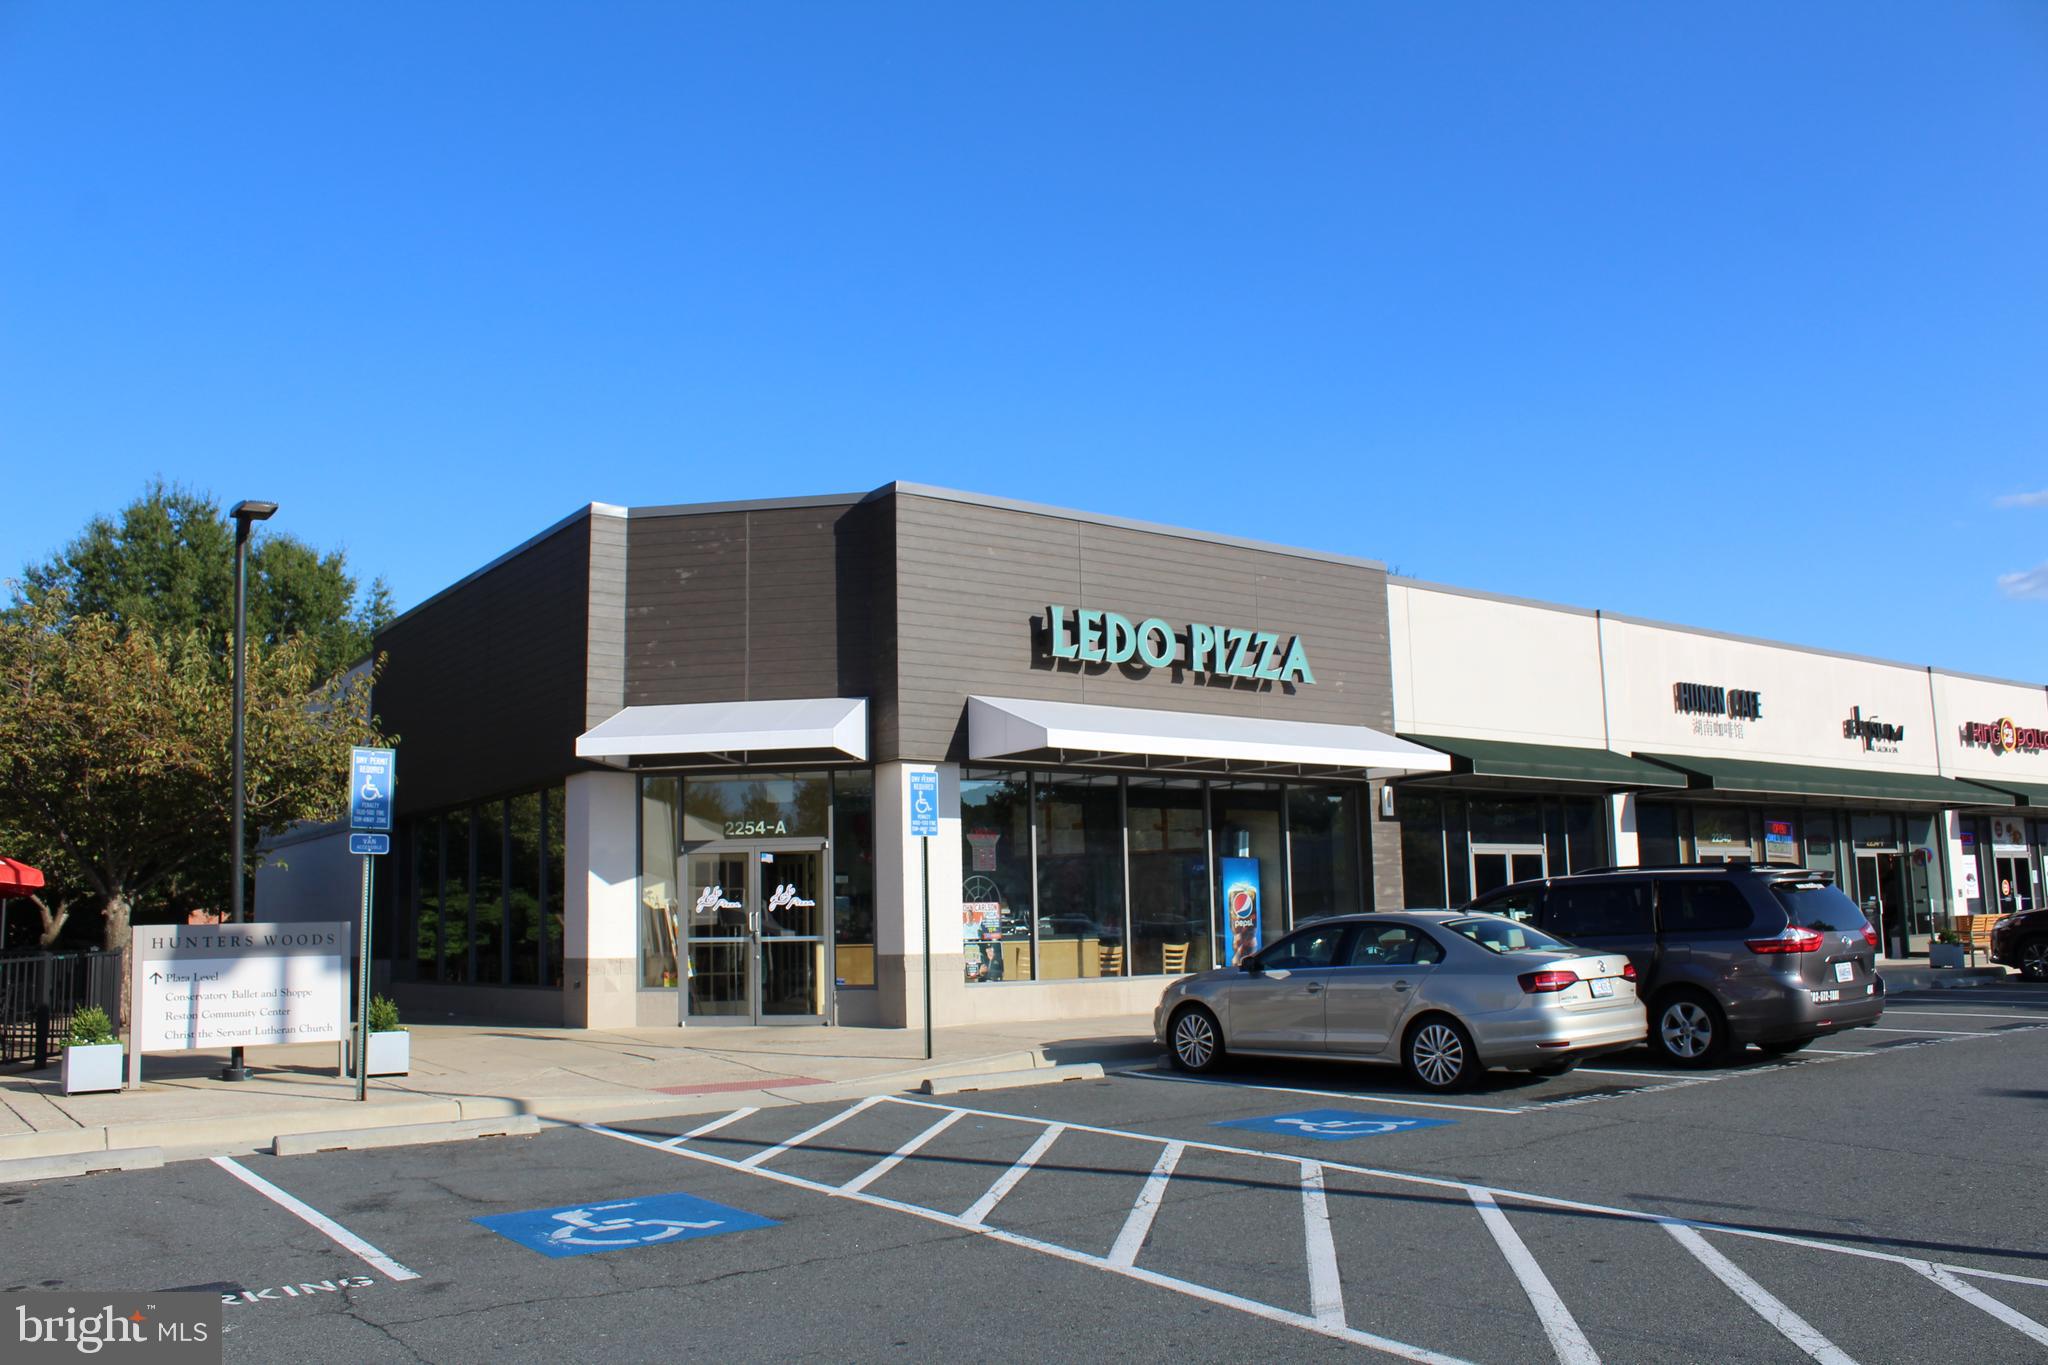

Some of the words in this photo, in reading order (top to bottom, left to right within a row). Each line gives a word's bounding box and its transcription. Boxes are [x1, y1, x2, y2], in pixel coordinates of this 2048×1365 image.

[1051, 605, 1177, 668] LEDO
[1191, 623, 1317, 685] PIZZA
[1677, 682, 1725, 714] HUNAN
[725, 820, 787, 836] 2254-A
[151, 935, 254, 949] HUNTERS
[264, 933, 335, 946] WOODS
[166, 973, 190, 983] Plaza
[193, 972, 219, 982] Level
[165, 991, 228, 1002] Conservatory
[232, 989, 258, 999] Ballet
[260, 988, 277, 998] and
[280, 987, 313, 999] Shoppe
[165, 1011, 198, 1021] Reston
[201, 1008, 257, 1020] Community
[259, 1006, 291, 1017] Center
[164, 1029, 195, 1040] Christ
[198, 1028, 213, 1038] the
[216, 1027, 251, 1037] Servant
[255, 1025, 296, 1036] Lutheran
[299, 1023, 334, 1033] Church
